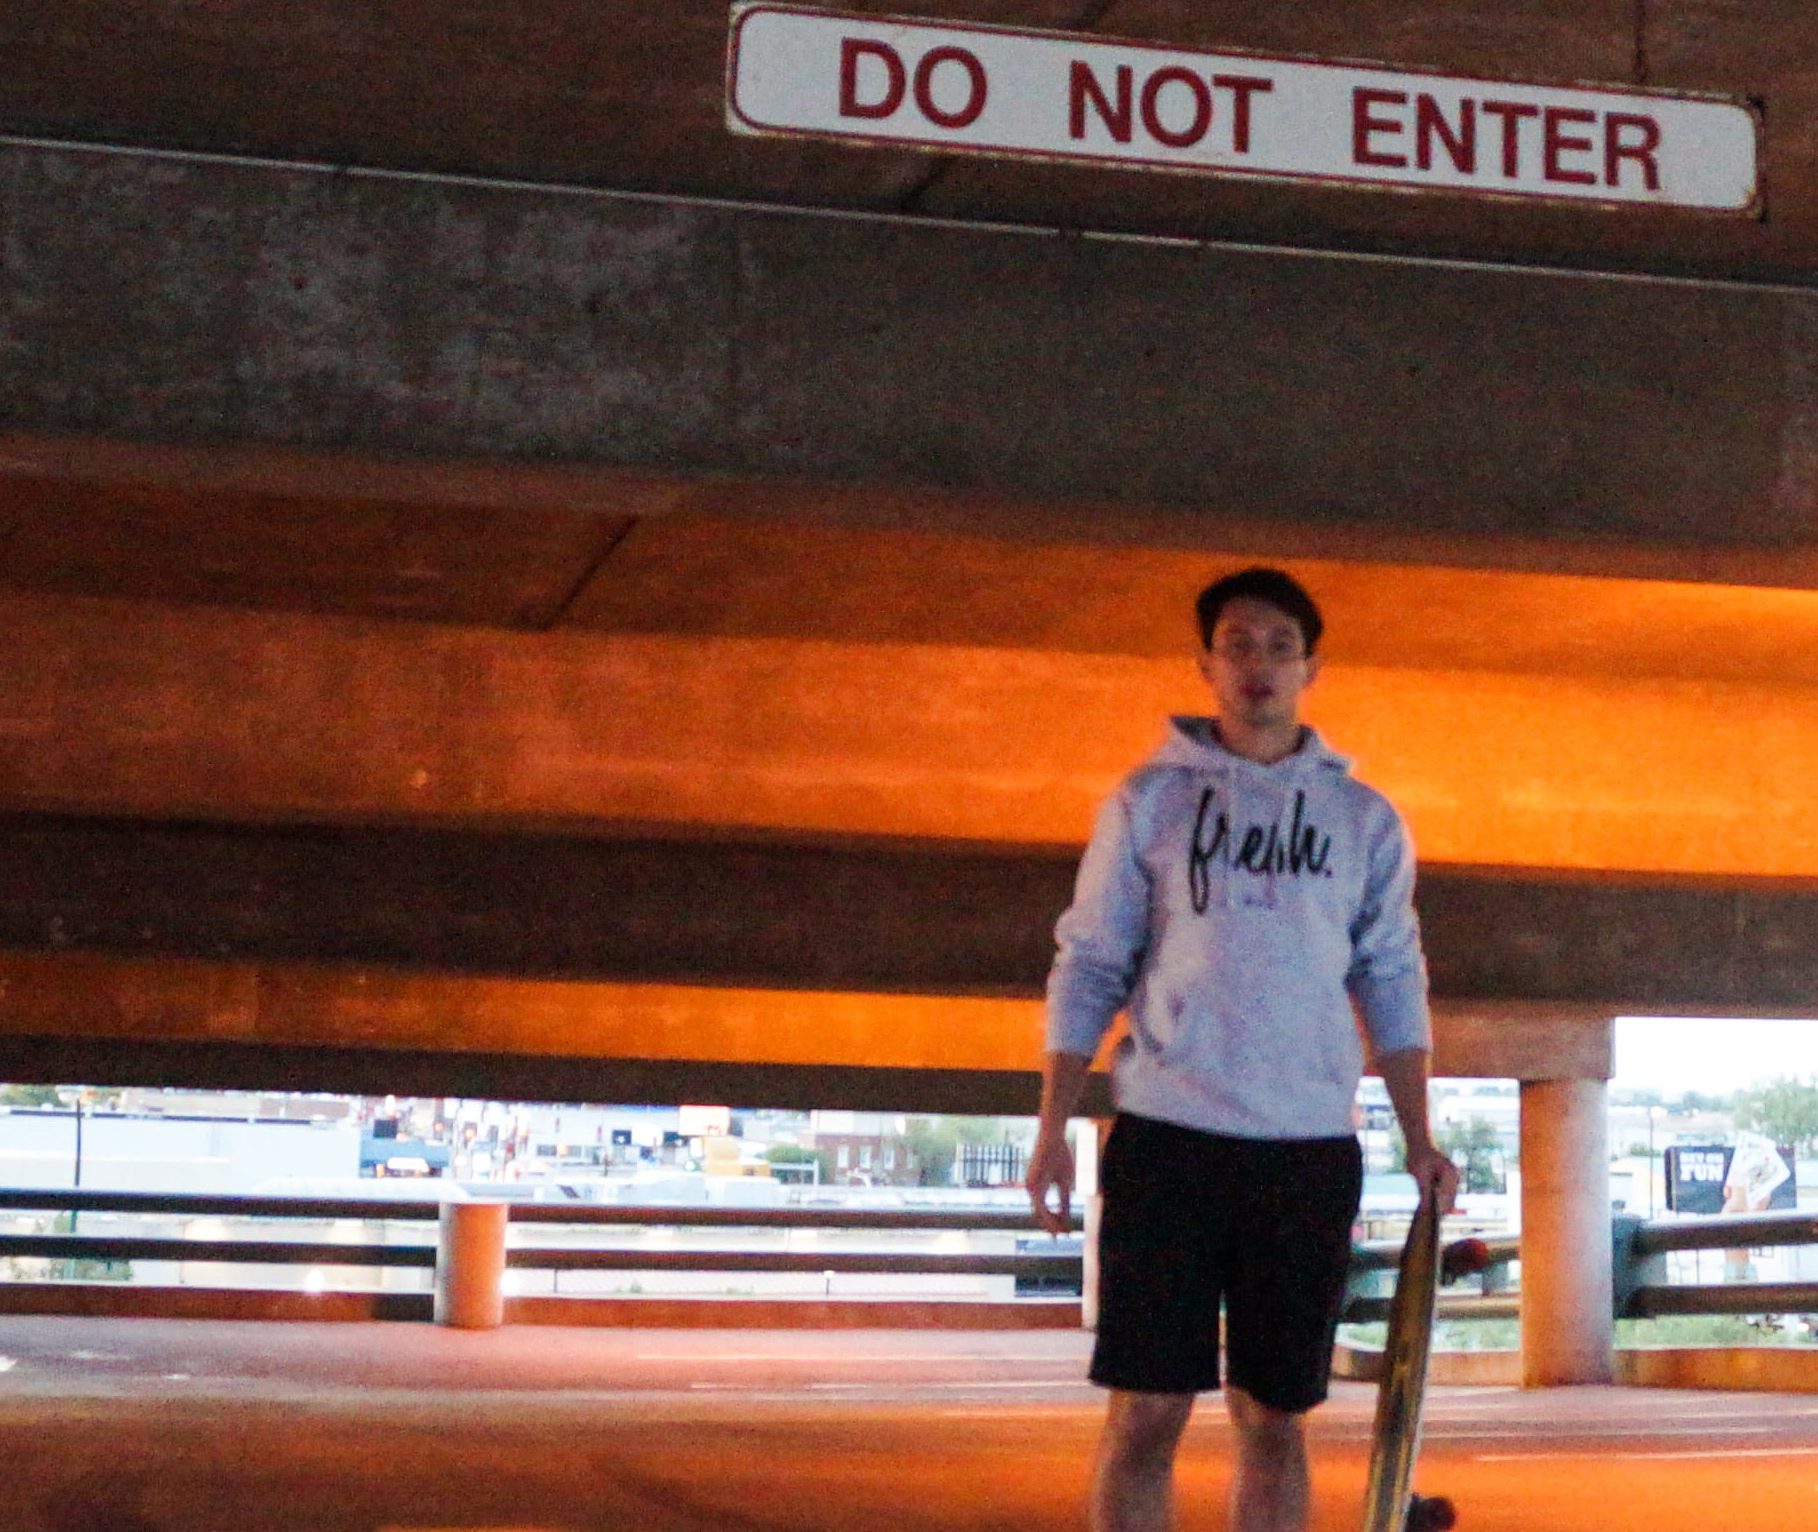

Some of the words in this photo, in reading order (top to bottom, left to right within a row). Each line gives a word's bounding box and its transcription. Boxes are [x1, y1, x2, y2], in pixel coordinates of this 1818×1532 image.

[838, 37, 988, 129] DO
[1067, 60, 1274, 154] NOT
[1351, 87, 1661, 191] ENTER
